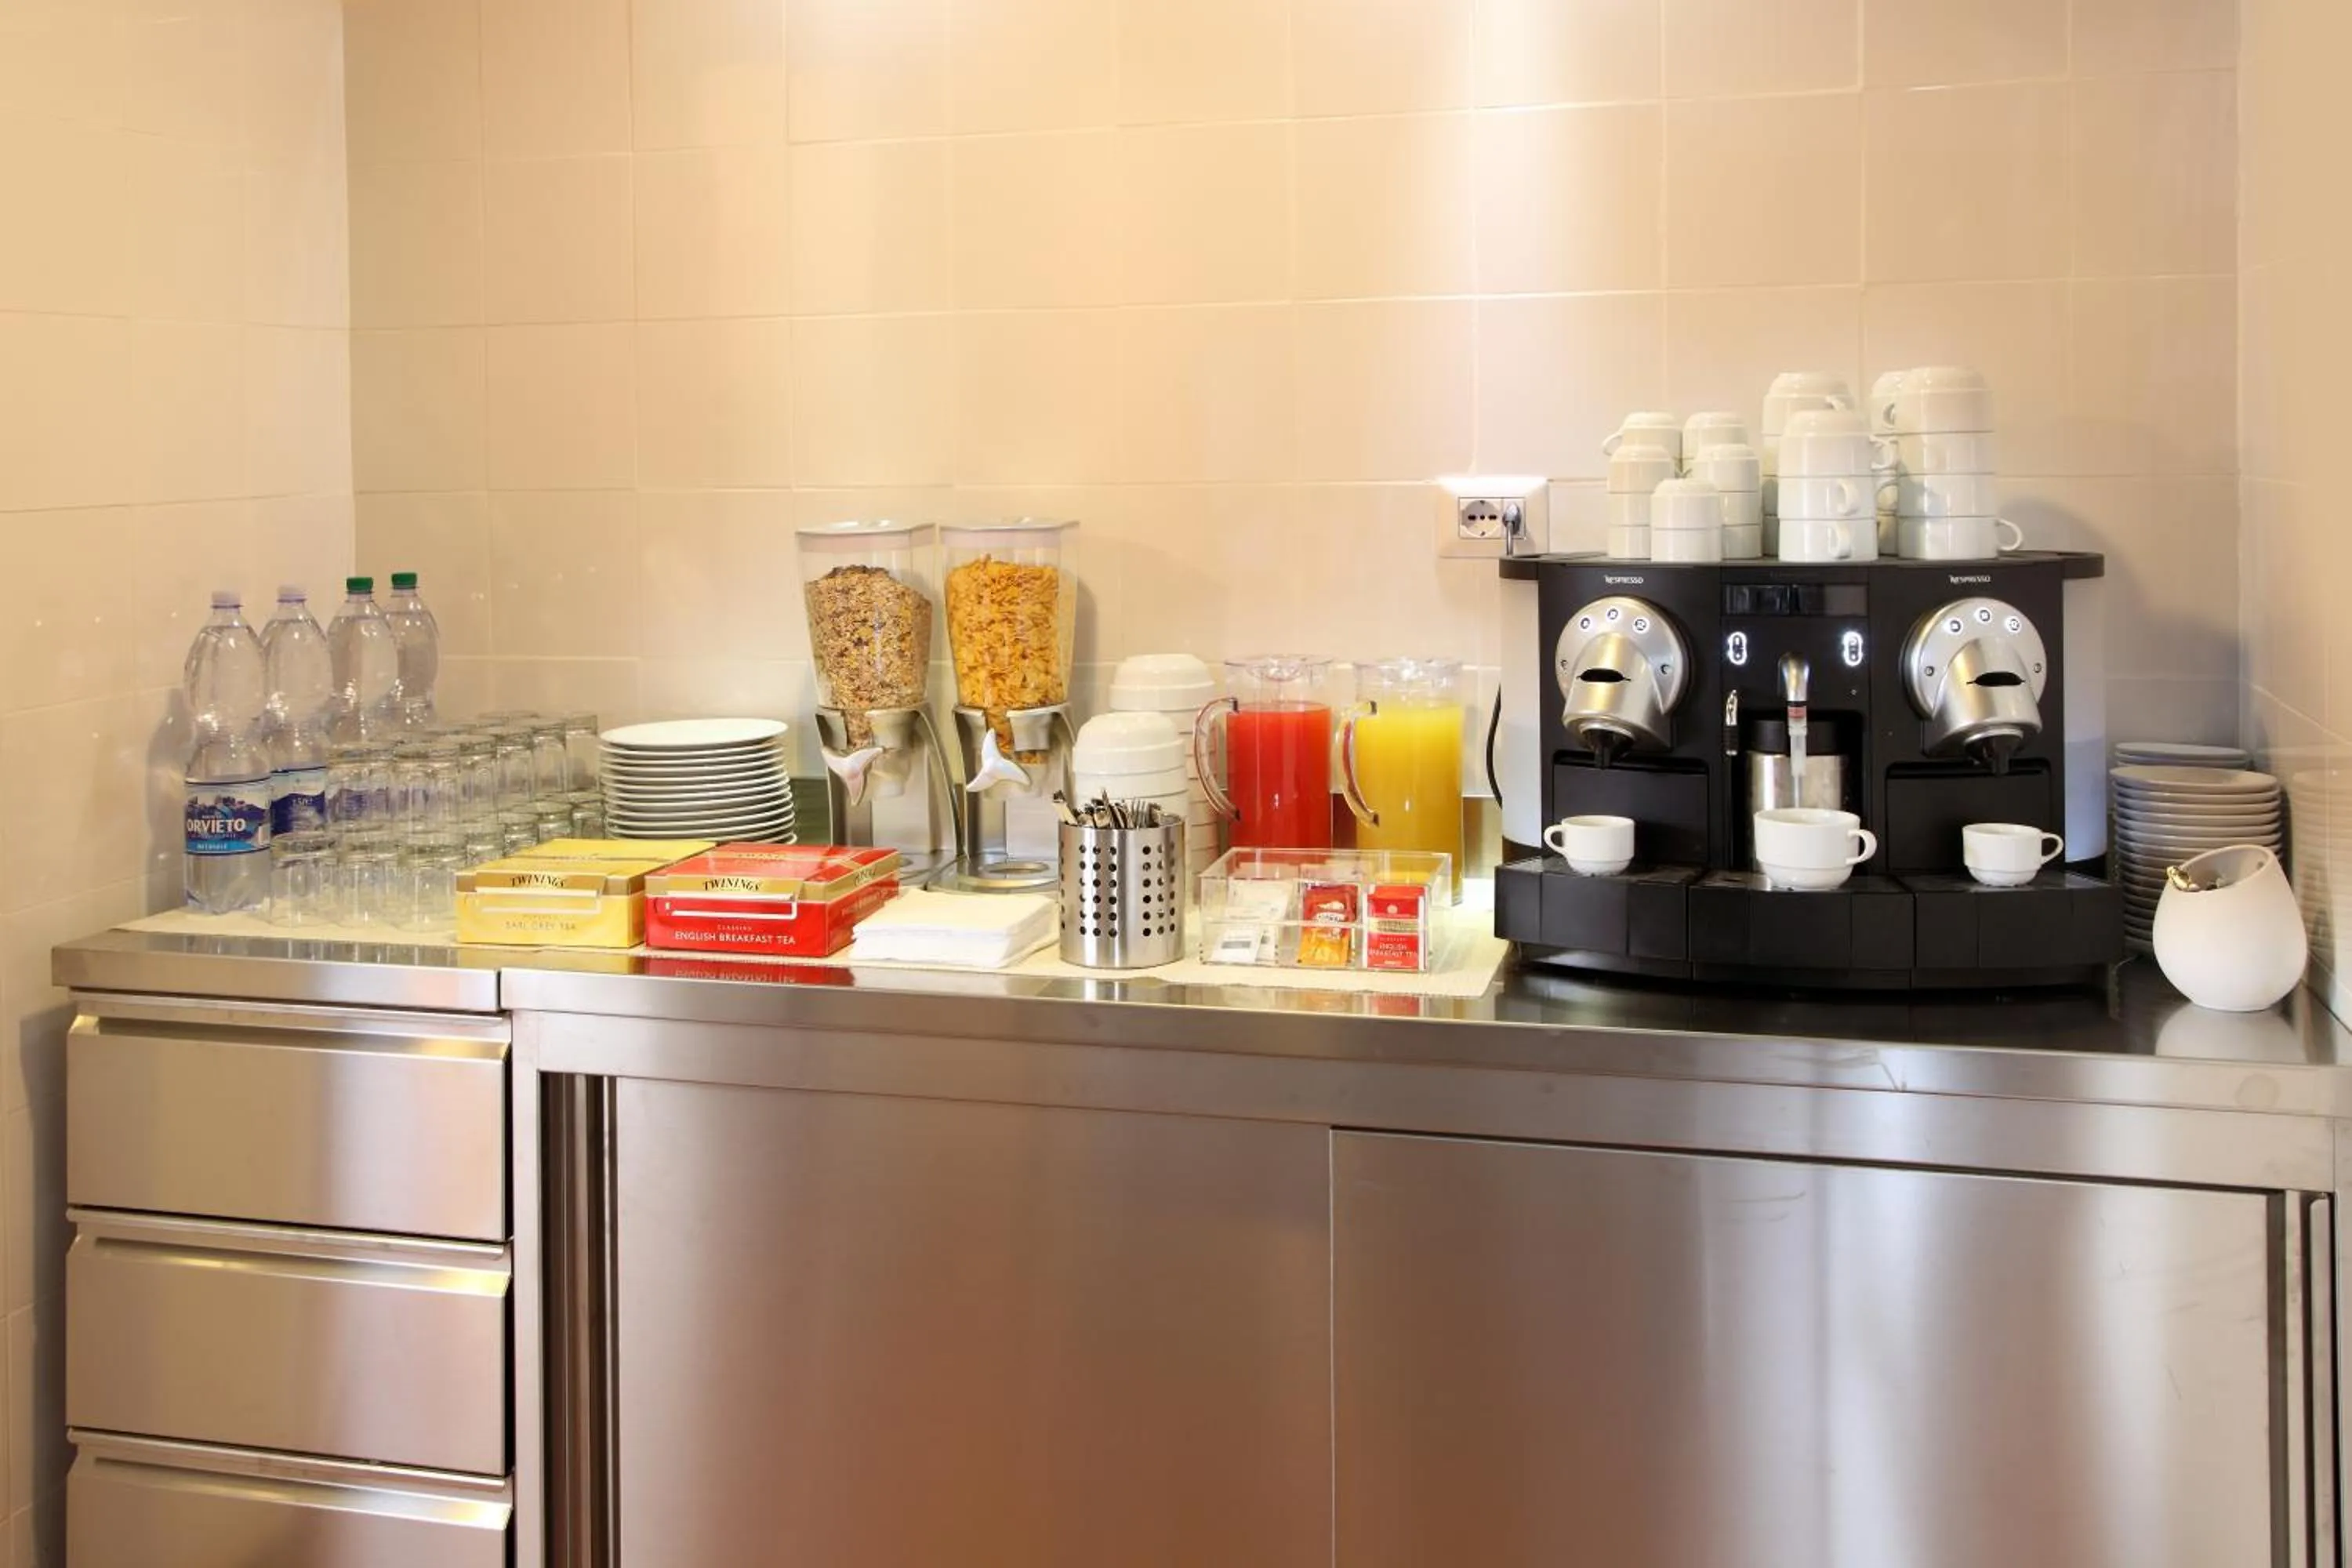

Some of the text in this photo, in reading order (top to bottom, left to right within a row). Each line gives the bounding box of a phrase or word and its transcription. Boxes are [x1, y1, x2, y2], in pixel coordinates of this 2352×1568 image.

[187, 818, 246, 833] ORVIETO
[510, 873, 566, 888] TWININGS
[702, 877, 761, 891] TWININGS
[675, 931, 796, 946] ENGLISH BREAKFAST TEA
